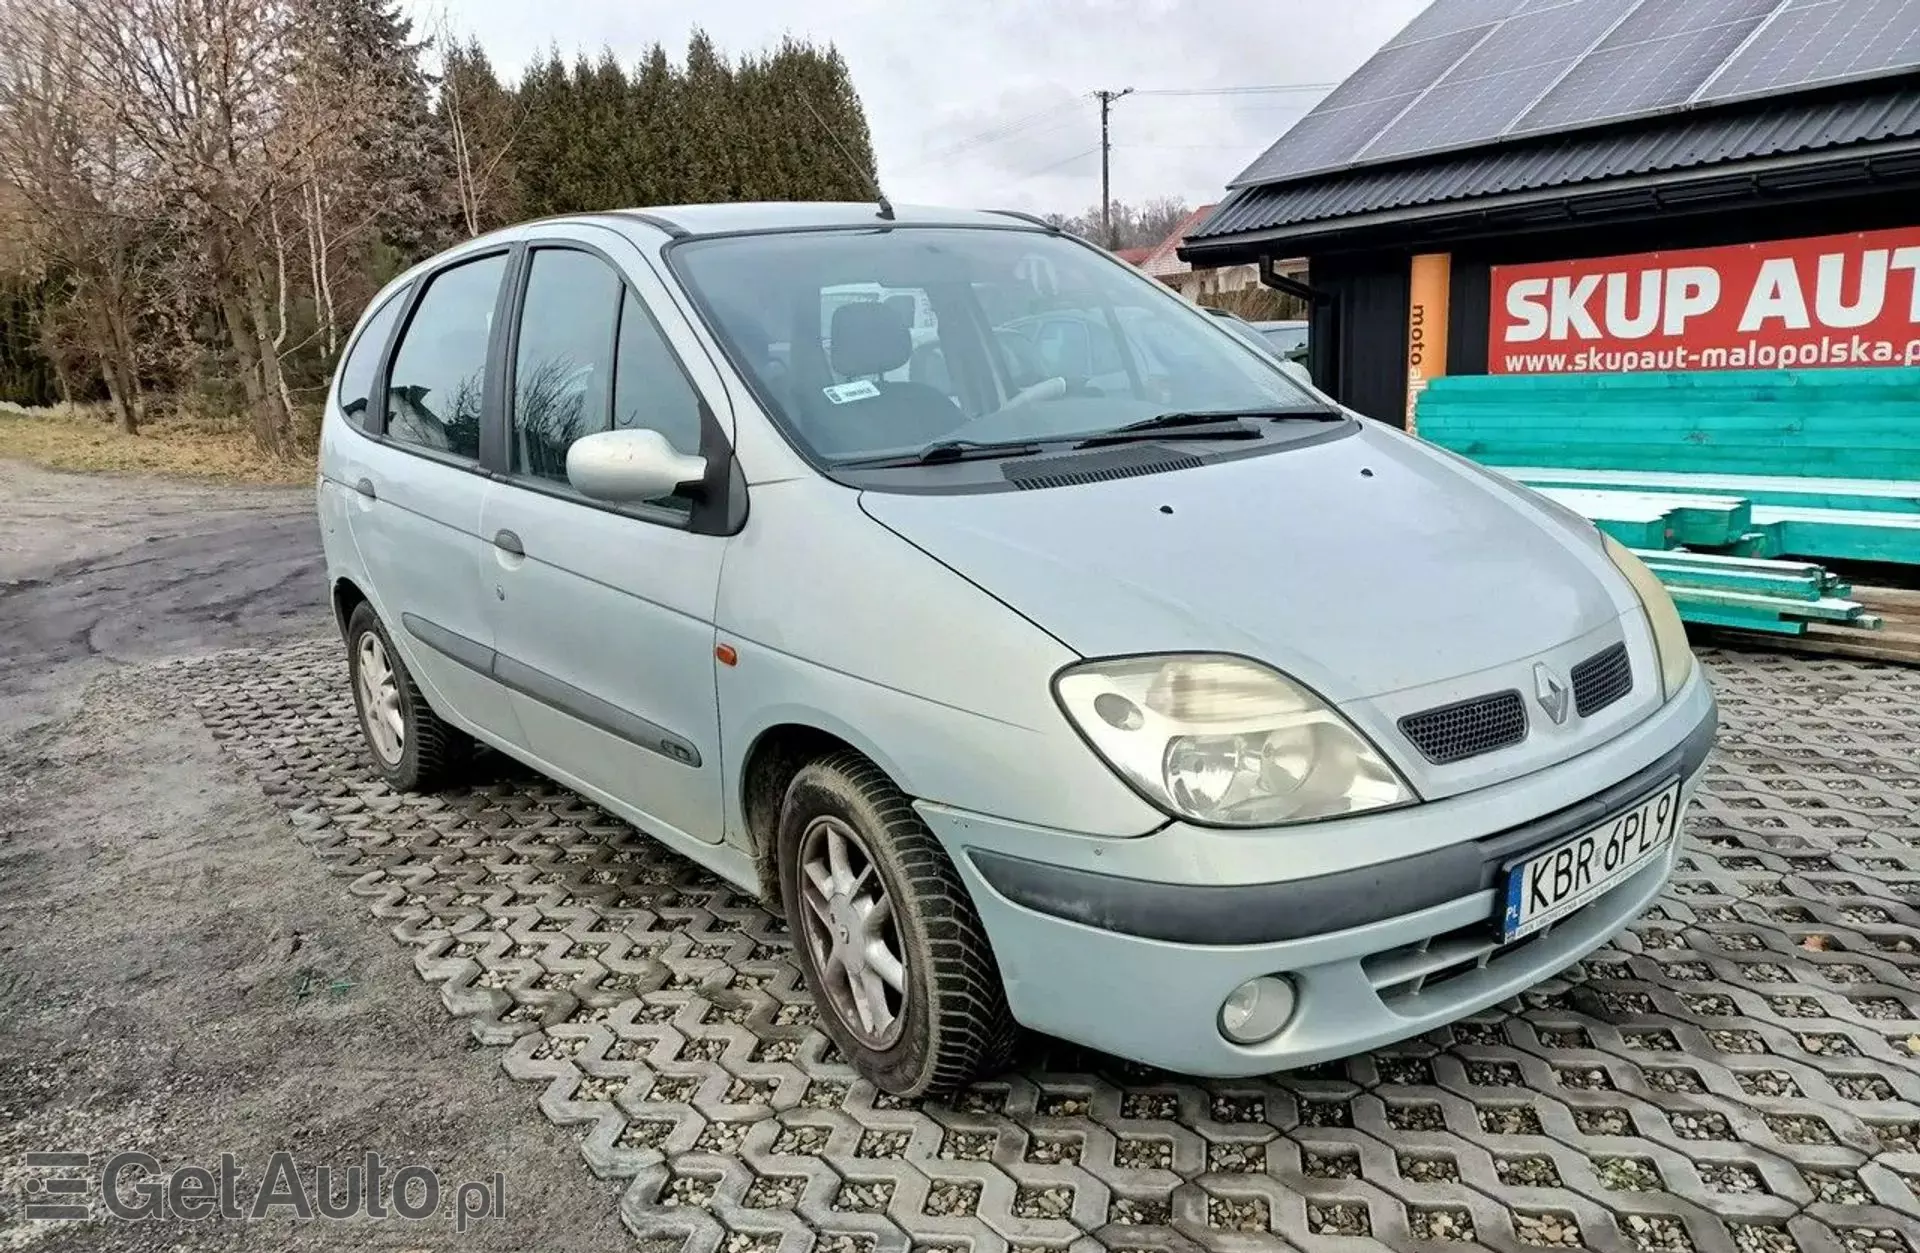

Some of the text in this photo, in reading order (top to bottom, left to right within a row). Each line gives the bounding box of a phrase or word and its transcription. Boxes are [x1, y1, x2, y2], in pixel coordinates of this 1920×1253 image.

[1505, 266, 1721, 342] SKUP
[1529, 836, 1595, 915] KBR
[1604, 792, 1671, 872] 6PL9
[1506, 904, 1519, 921] PL
